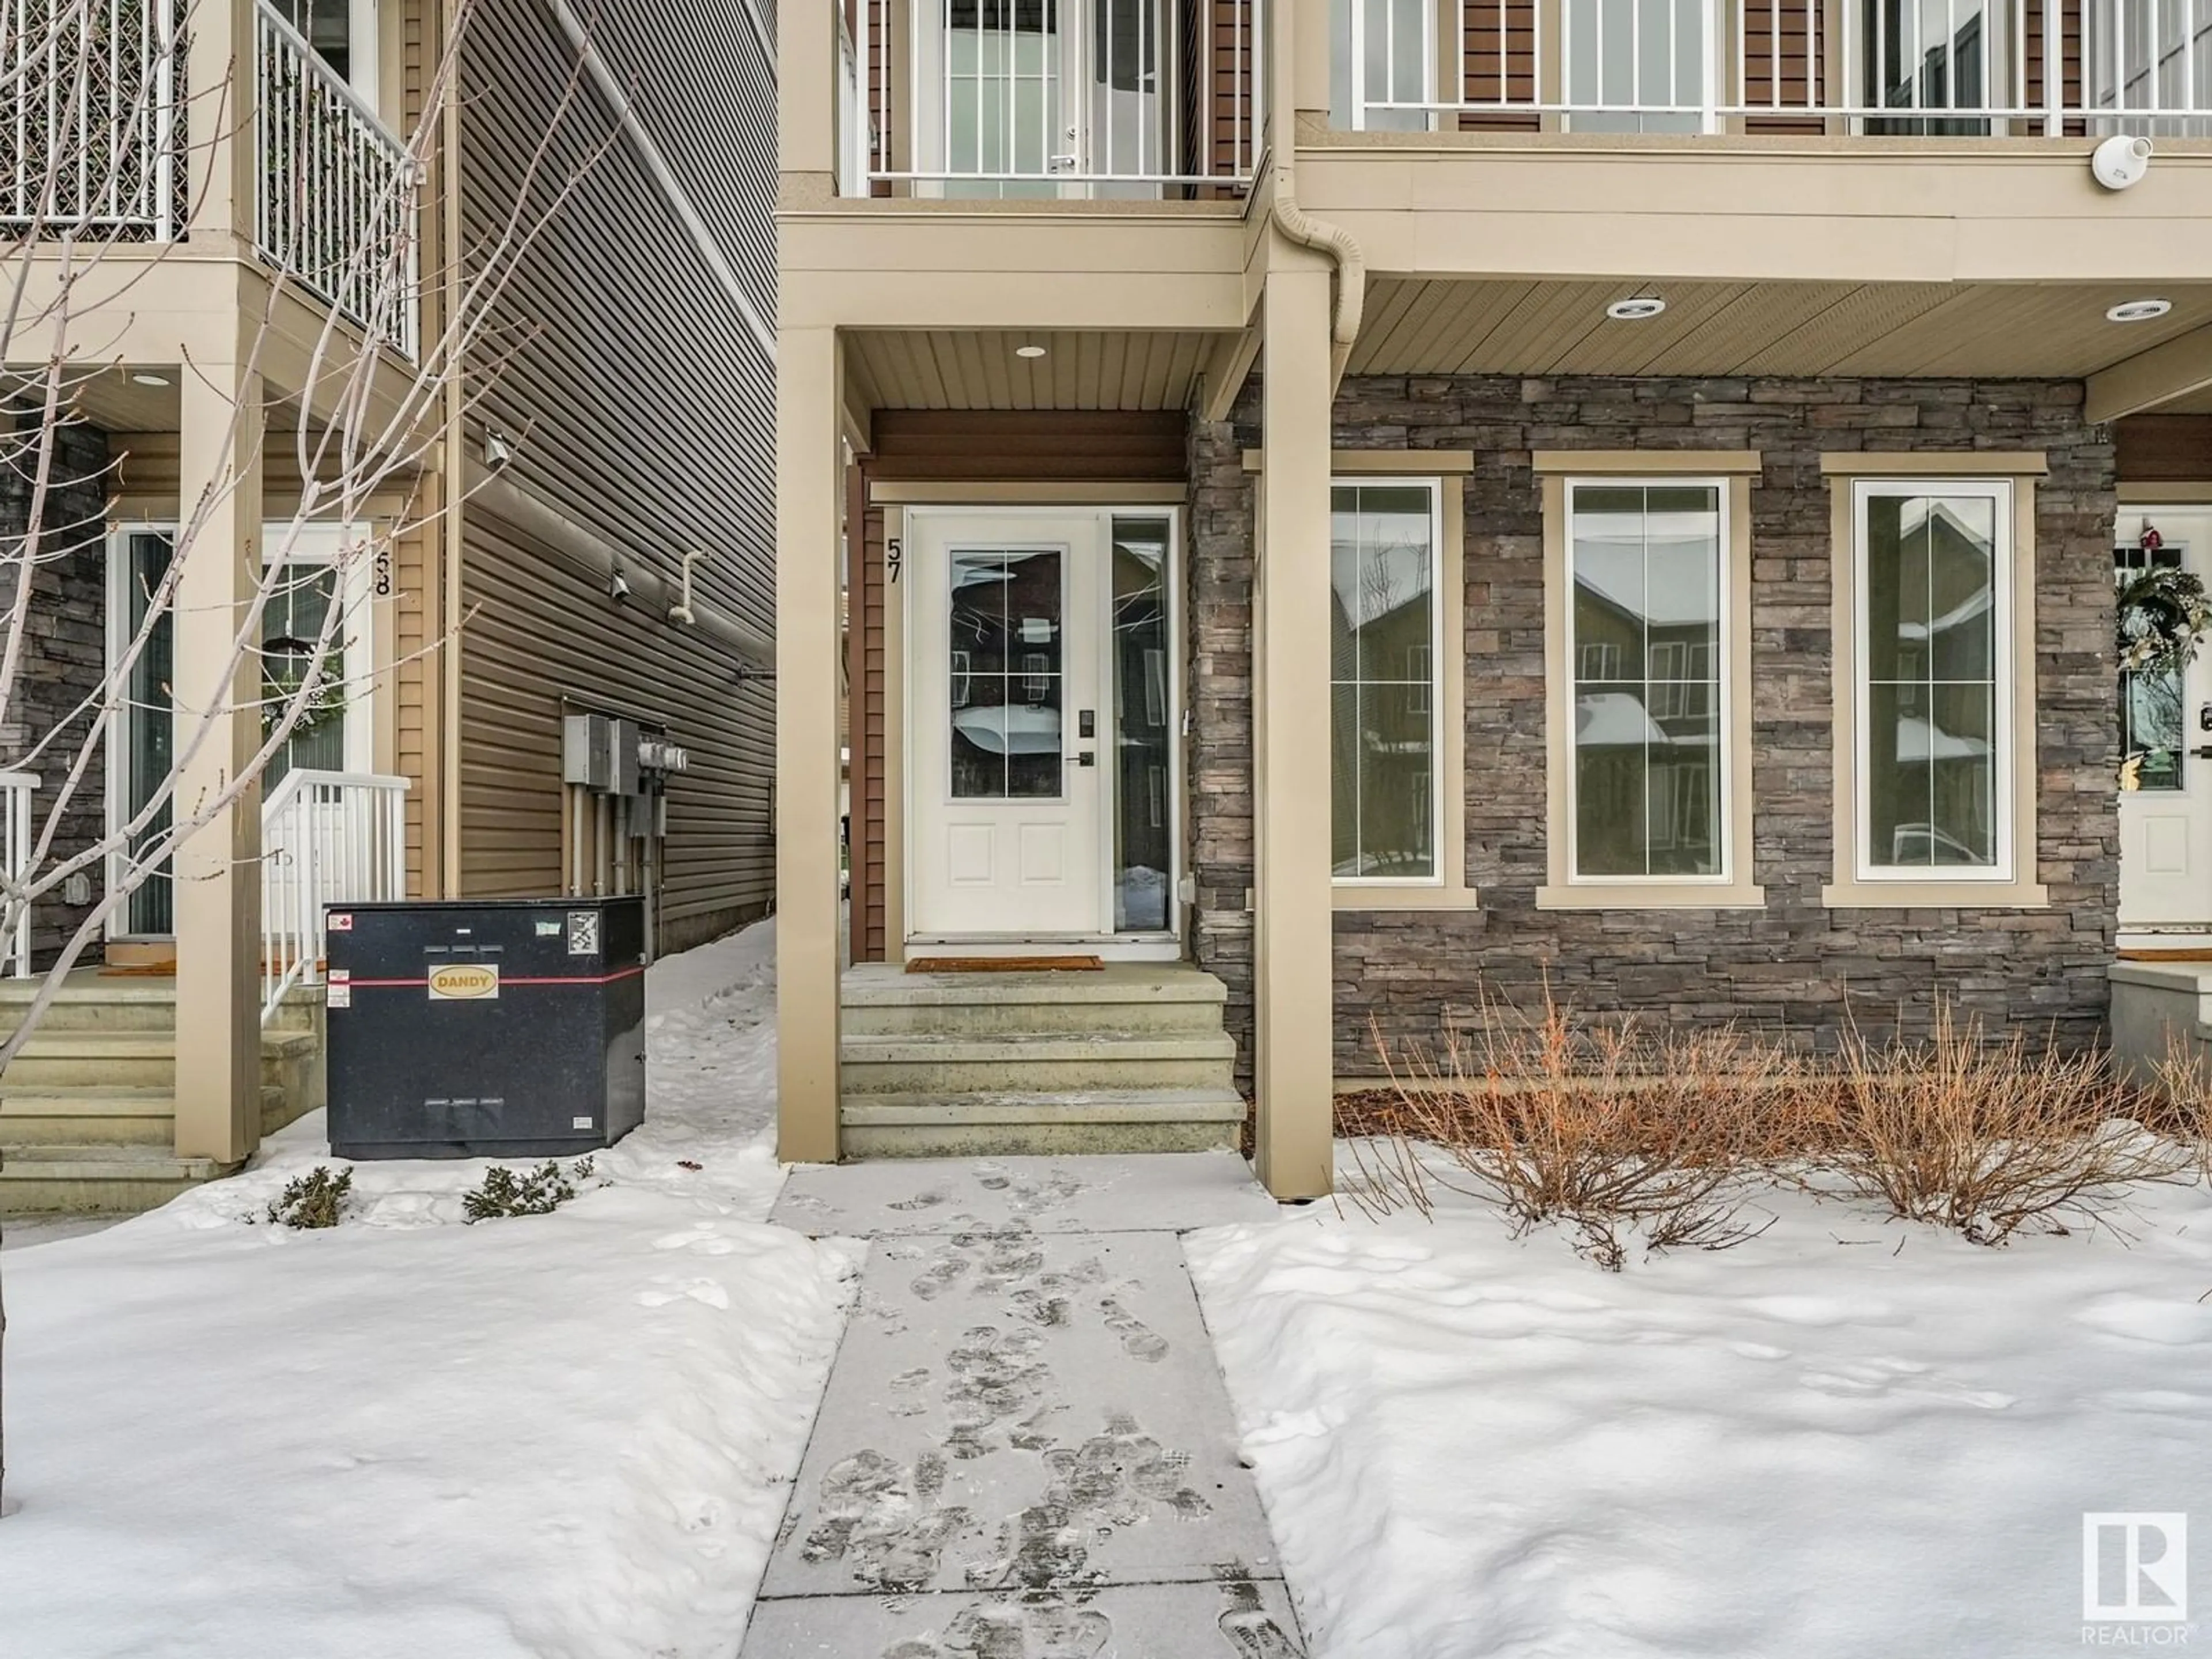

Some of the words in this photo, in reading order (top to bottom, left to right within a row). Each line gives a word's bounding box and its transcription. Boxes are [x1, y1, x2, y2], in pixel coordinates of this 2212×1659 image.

[376, 551, 389, 596] 58
[888, 538, 901, 584] 57
[438, 976, 489, 987] DANDY
